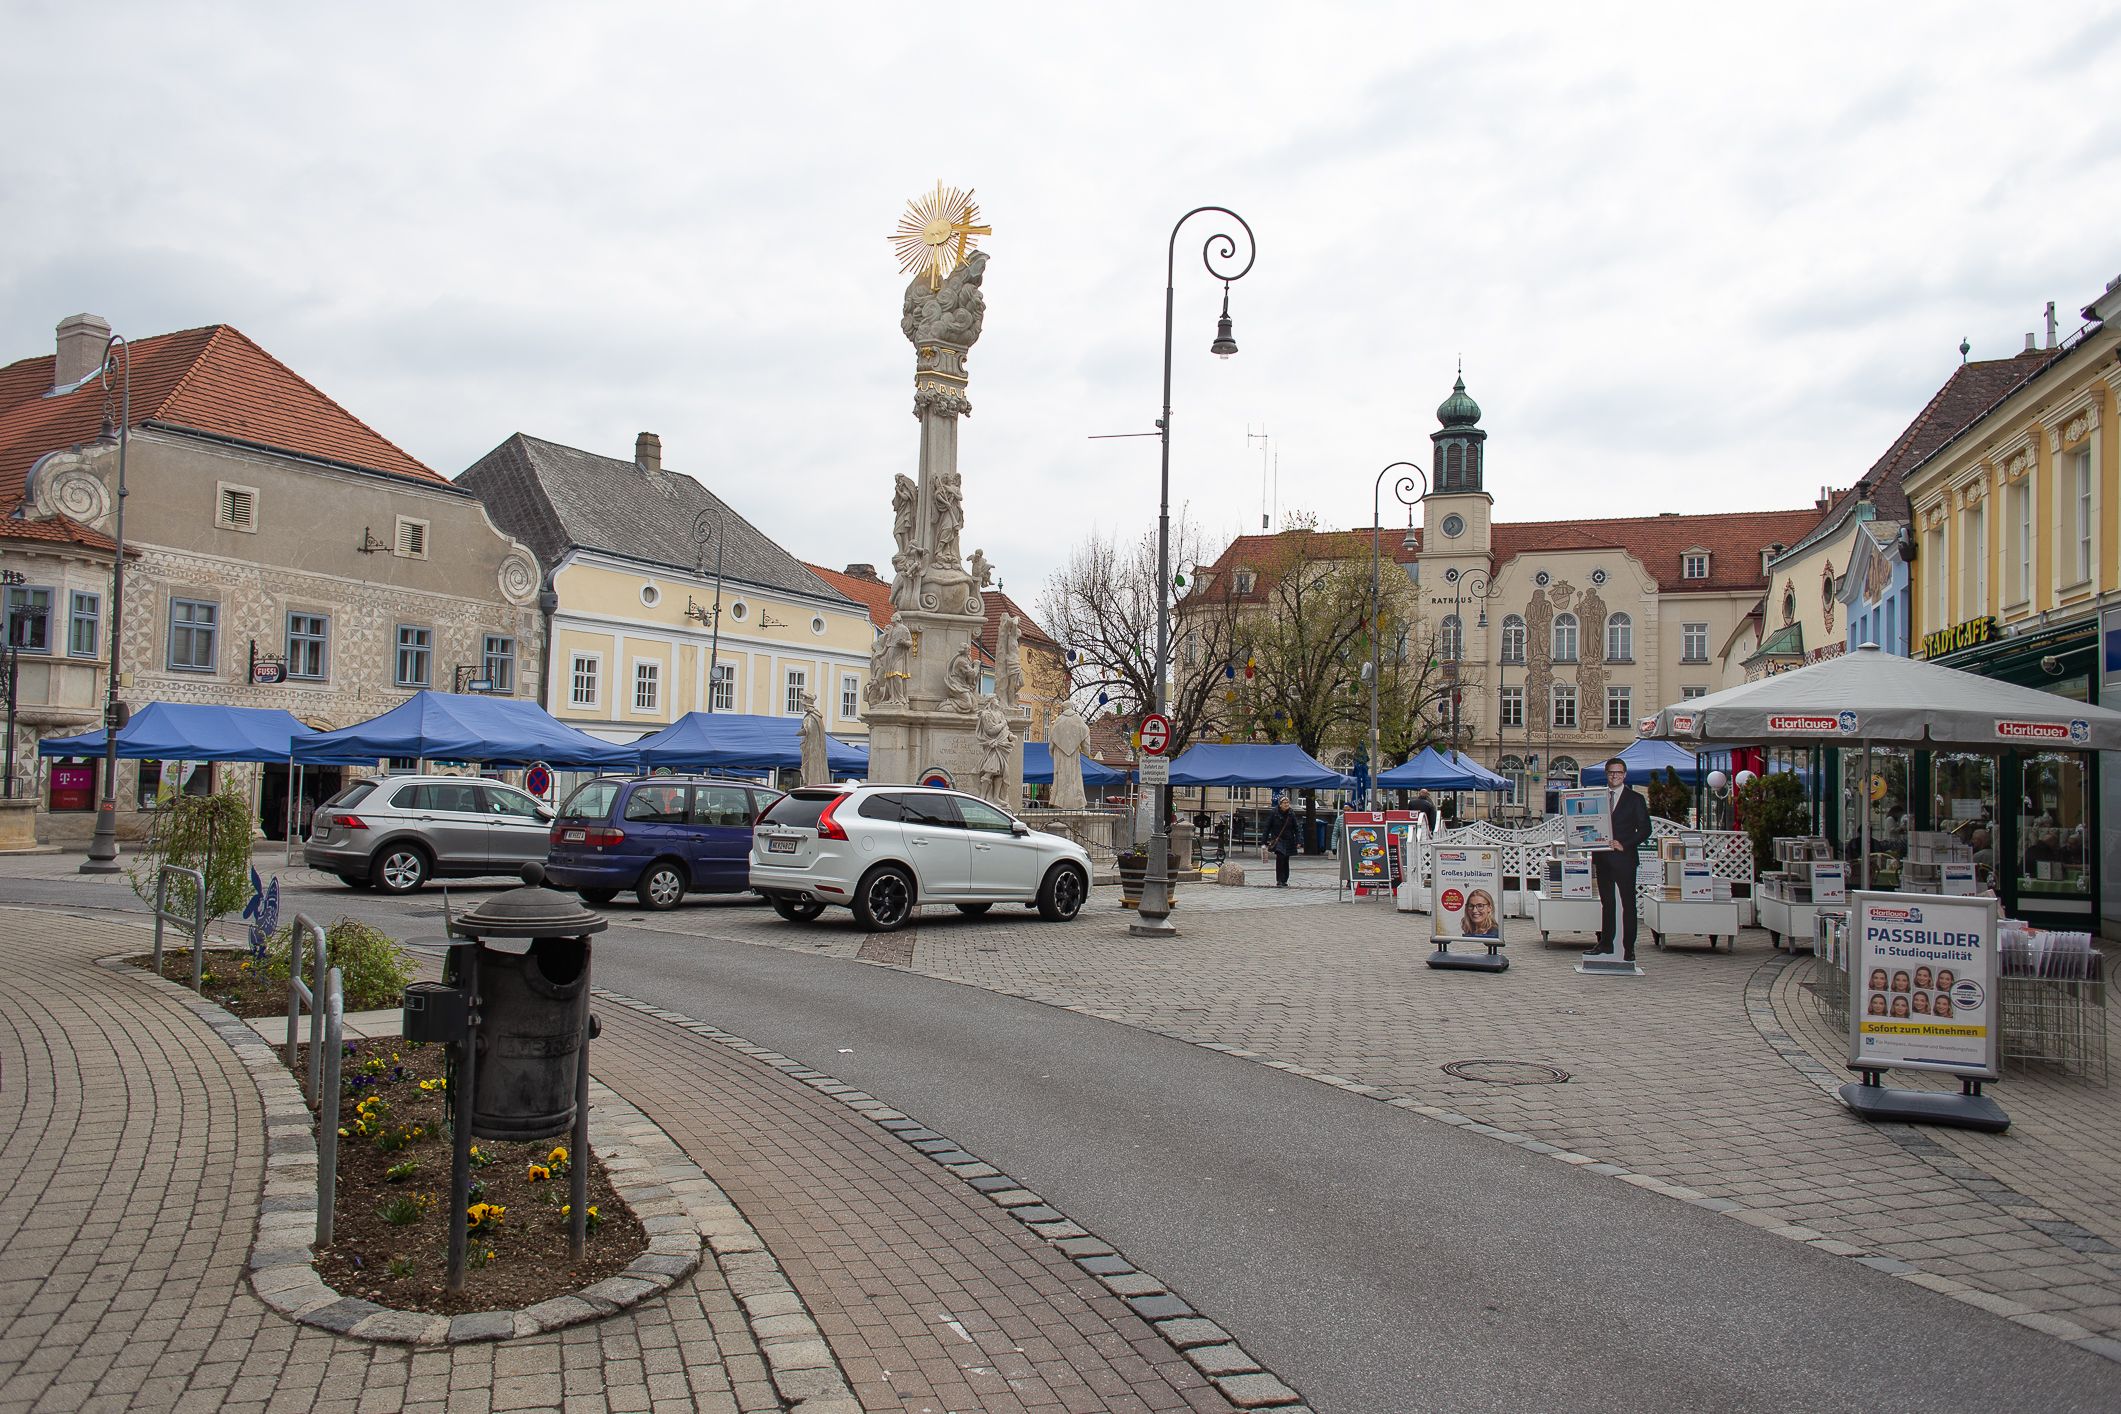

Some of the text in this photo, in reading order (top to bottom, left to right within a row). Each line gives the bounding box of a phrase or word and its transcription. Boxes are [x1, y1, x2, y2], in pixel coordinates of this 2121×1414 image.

[1775, 718, 1834, 730] Hartlauer
[2003, 723, 2064, 737] Hartlauer
[1872, 908, 1907, 918] Hartlauer
[1867, 927, 1980, 948] PASSBILDER
[1874, 945, 1972, 960] in Studioqualität
[1868, 1024, 1897, 1033] Sofort
[1923, 1026, 1978, 1036] Mitnehmen
